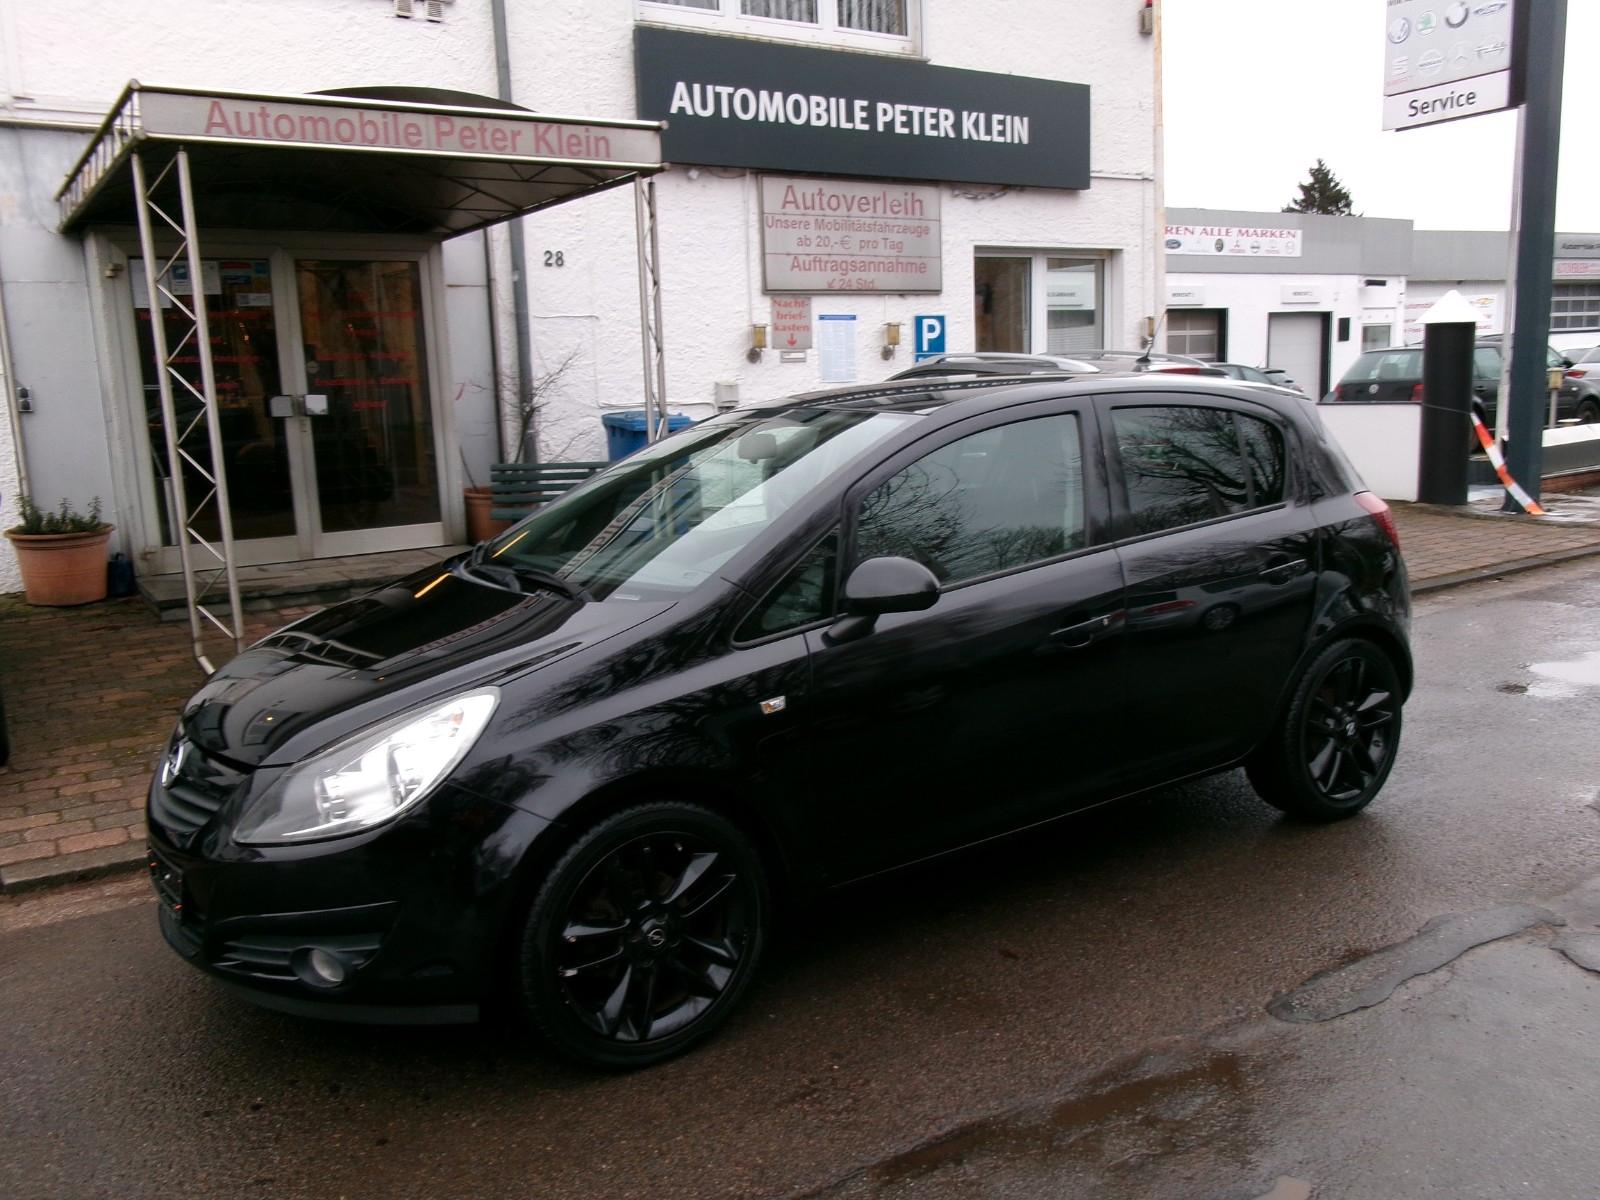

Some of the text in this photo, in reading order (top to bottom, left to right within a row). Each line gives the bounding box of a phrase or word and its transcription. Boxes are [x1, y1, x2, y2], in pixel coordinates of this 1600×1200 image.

[669, 81, 1030, 145] AUTOMOBILE PETER KLEIN
[1408, 90, 1477, 118] Service
[203, 100, 612, 159] Automobile Peter Klein
[781, 184, 925, 217] Autoverleih
[765, 215, 931, 238] Unsere Mobilitätsfahrzeuge
[1199, 226, 1233, 237] ALLE
[1236, 229, 1297, 239] MARKEN
[796, 234, 812, 248] ab
[859, 238, 879, 251] pro
[880, 237, 904, 254] Tag
[543, 250, 565, 268] 28
[790, 255, 928, 277] Auftragsannahme
[773, 323, 811, 333] kasten
[922, 318, 941, 352] P
